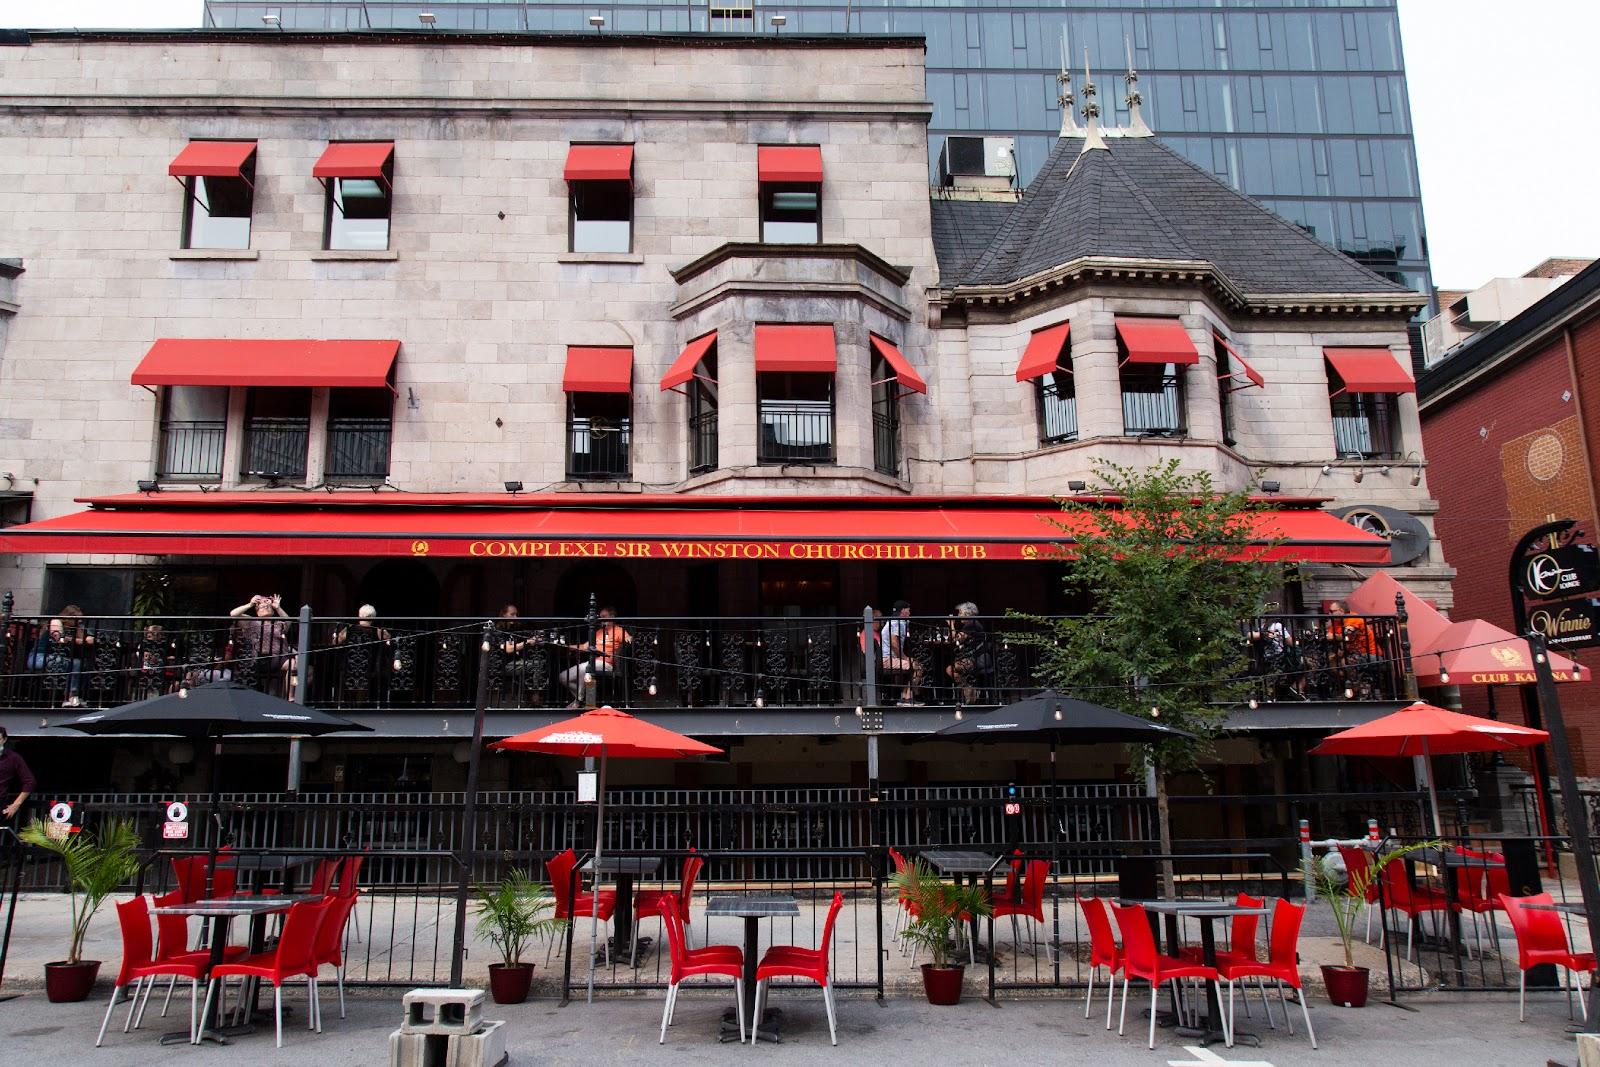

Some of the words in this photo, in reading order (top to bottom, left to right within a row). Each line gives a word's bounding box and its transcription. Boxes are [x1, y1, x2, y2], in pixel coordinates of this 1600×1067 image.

[469, 541, 608, 557] COMPLEXE
[614, 541, 652, 557] SIR
[660, 542, 781, 558] WINSTON
[789, 543, 933, 559] CHURCHILL
[939, 543, 987, 560] PUB
[1561, 572, 1578, 582] CLUB
[1531, 607, 1592, 638] Winnie
[1471, 673, 1509, 683] CLUB
[1514, 671, 1569, 682] KANA
